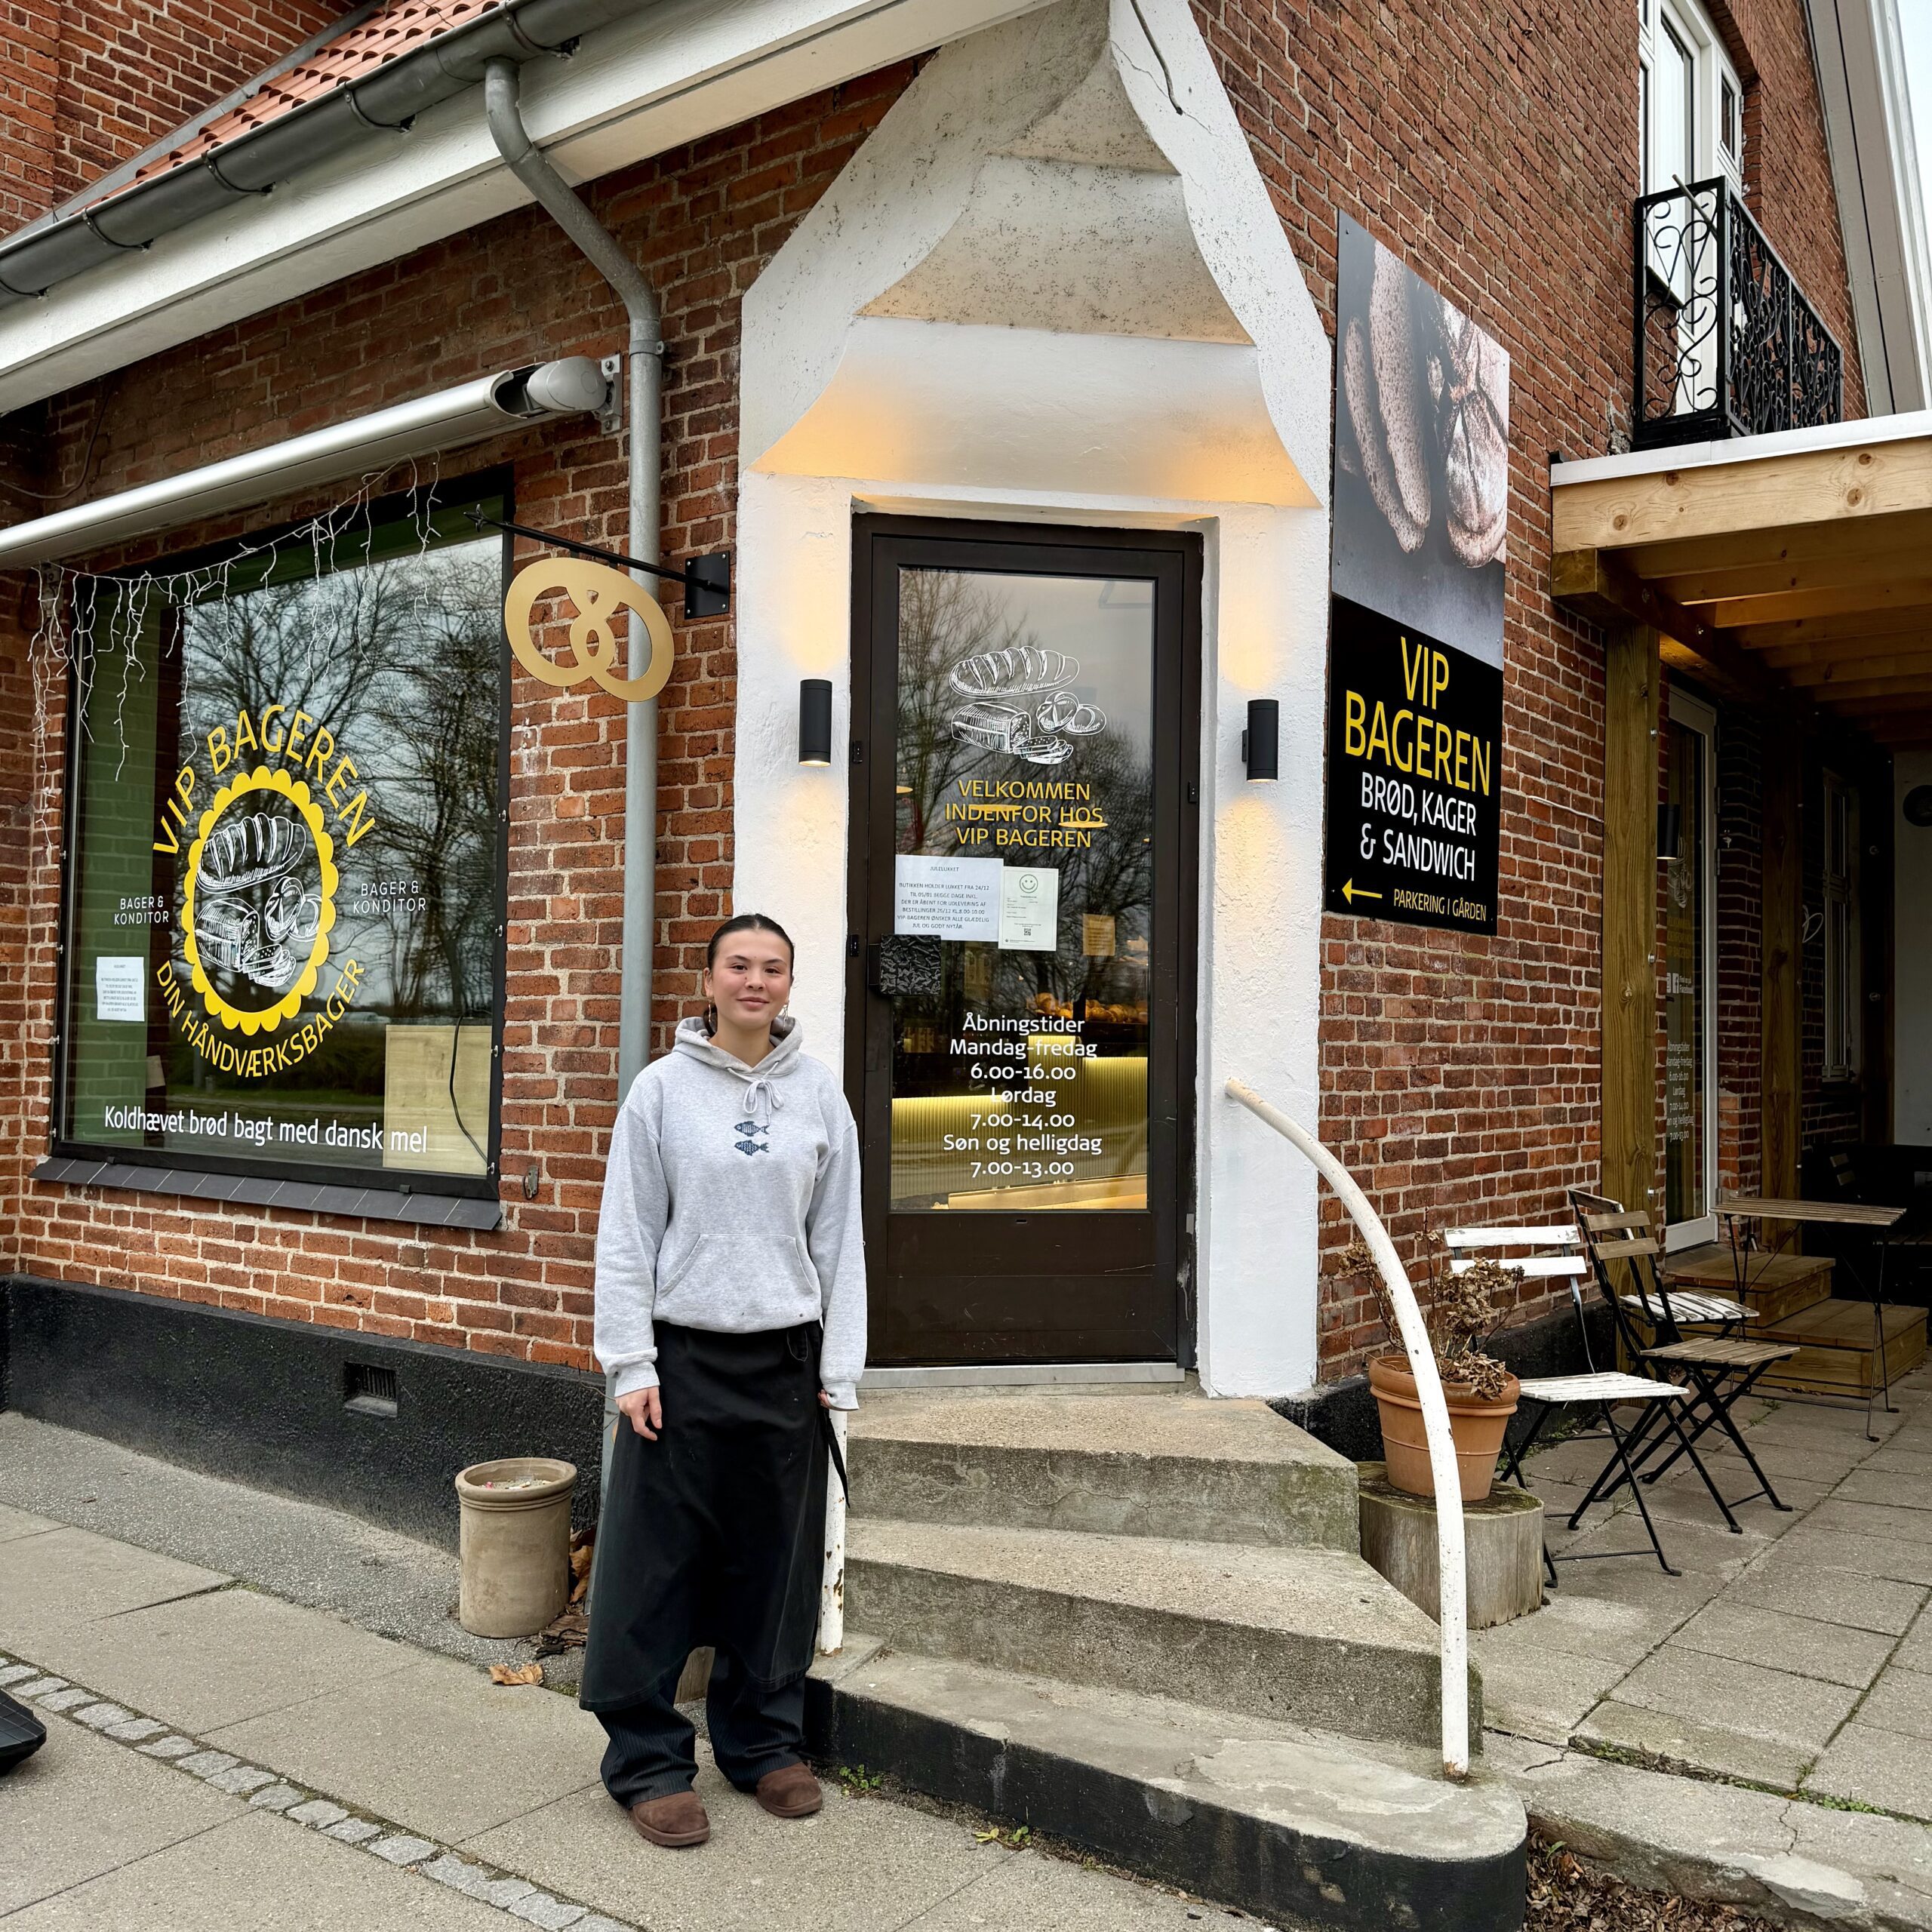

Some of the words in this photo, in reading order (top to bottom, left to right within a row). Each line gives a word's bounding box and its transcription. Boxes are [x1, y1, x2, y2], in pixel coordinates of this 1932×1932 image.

[1401, 636, 1449, 709] VIP
[1345, 690, 1491, 796] BAGEREN
[153, 766, 195, 854] VIP
[208, 705, 375, 847] BAGEREN
[958, 780, 1090, 800] VELKOMMEN
[945, 803, 1051, 823] INDENFOR
[1060, 807, 1103, 823] HOS
[1361, 771, 1417, 826] BRØD,
[1422, 789, 1476, 836] KAGER
[956, 827, 989, 844] VIP
[996, 829, 1091, 848] BAGEREN
[1361, 823, 1376, 860] &
[1383, 829, 1475, 881] SANDWICH
[361, 881, 406, 896] BAGER
[411, 881, 419, 894] &
[120, 897, 154, 910] BAGER
[157, 896, 164, 908] &
[353, 897, 426, 914] KONDITOR
[1394, 888, 1444, 915] PARKERING
[1453, 897, 1487, 921] GÅRDEN
[114, 911, 169, 925] KONDITOR
[157, 960, 185, 1018] DIN
[181, 958, 365, 1078] HÅNDVÆRKSBAGER
[962, 1011, 1085, 1035] Åbningstider
[949, 1038, 1098, 1060] Mandag-fredag
[971, 1063, 1076, 1080] 6.00-16.00
[992, 1087, 1057, 1107] Lørdag
[105, 1106, 185, 1133] Koldhævet
[189, 1109, 227, 1137] brød
[234, 1112, 273, 1146] bagt
[279, 1118, 318, 1145] med
[325, 1119, 383, 1150] dansk
[391, 1125, 427, 1153] mel
[970, 1114, 1075, 1131] 7.00-14.00
[943, 1134, 979, 1151] Søn
[986, 1137, 1011, 1155] og
[1017, 1134, 1103, 1155] helligdag
[970, 1161, 1075, 1178] 7.00-13.00
